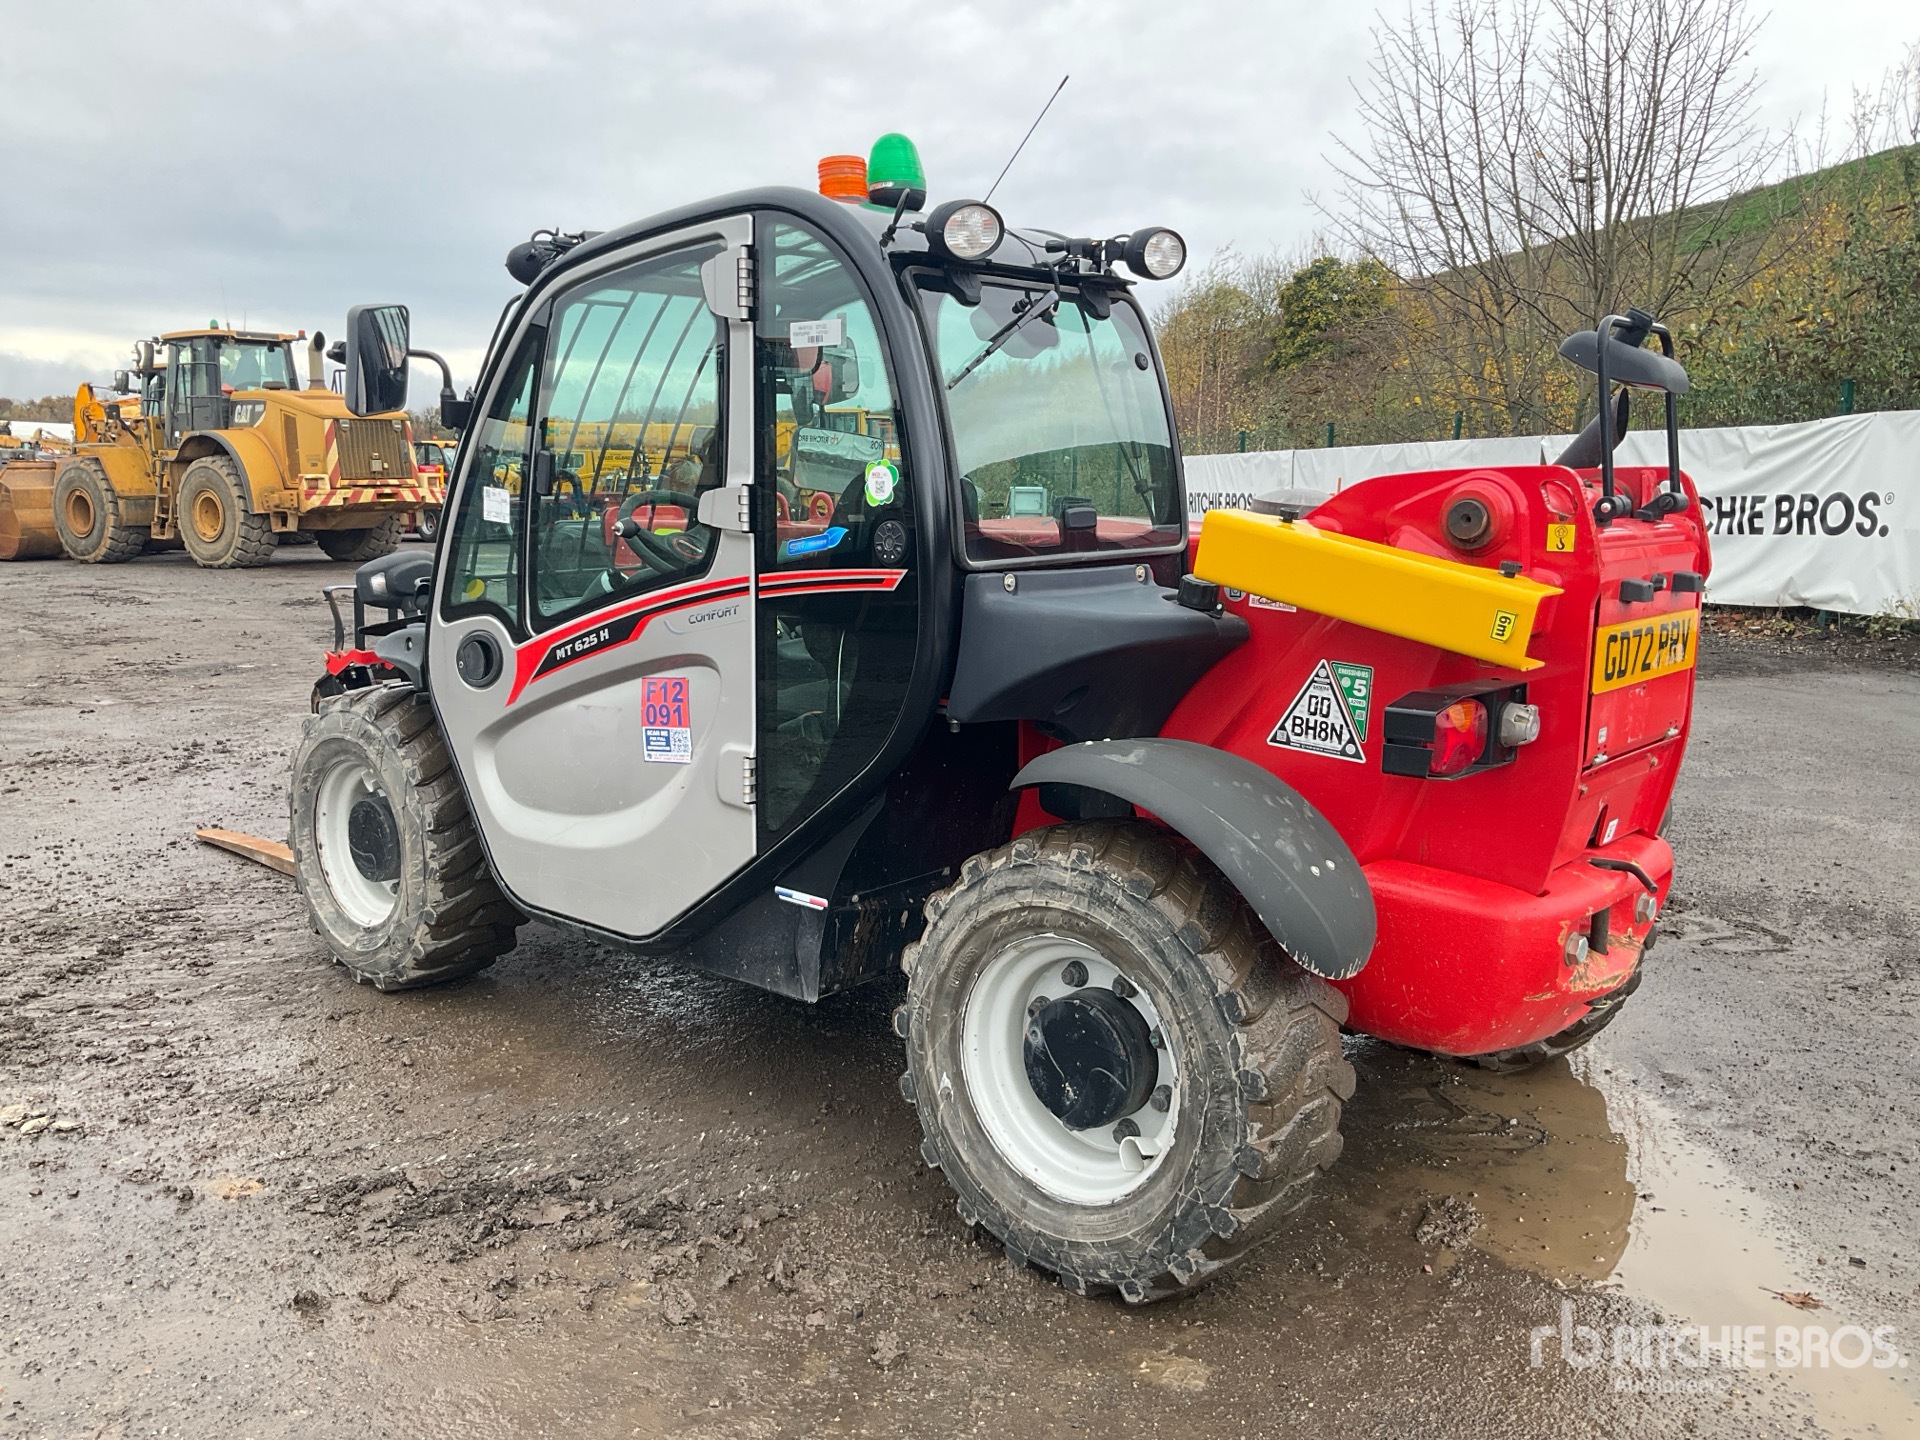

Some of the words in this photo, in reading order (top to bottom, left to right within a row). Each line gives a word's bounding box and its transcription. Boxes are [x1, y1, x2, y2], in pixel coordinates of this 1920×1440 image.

[235, 404, 252, 423] CAT
[1495, 615, 1511, 637] 6m
[556, 644, 573, 660] MT
[574, 634, 598, 652] 625
[599, 628, 610, 641] H
[1604, 626, 1654, 682] GD72
[646, 681, 684, 703] F12
[1352, 678, 1367, 697] 5
[646, 703, 683, 726] 091
[1291, 715, 1344, 745] BH8N
